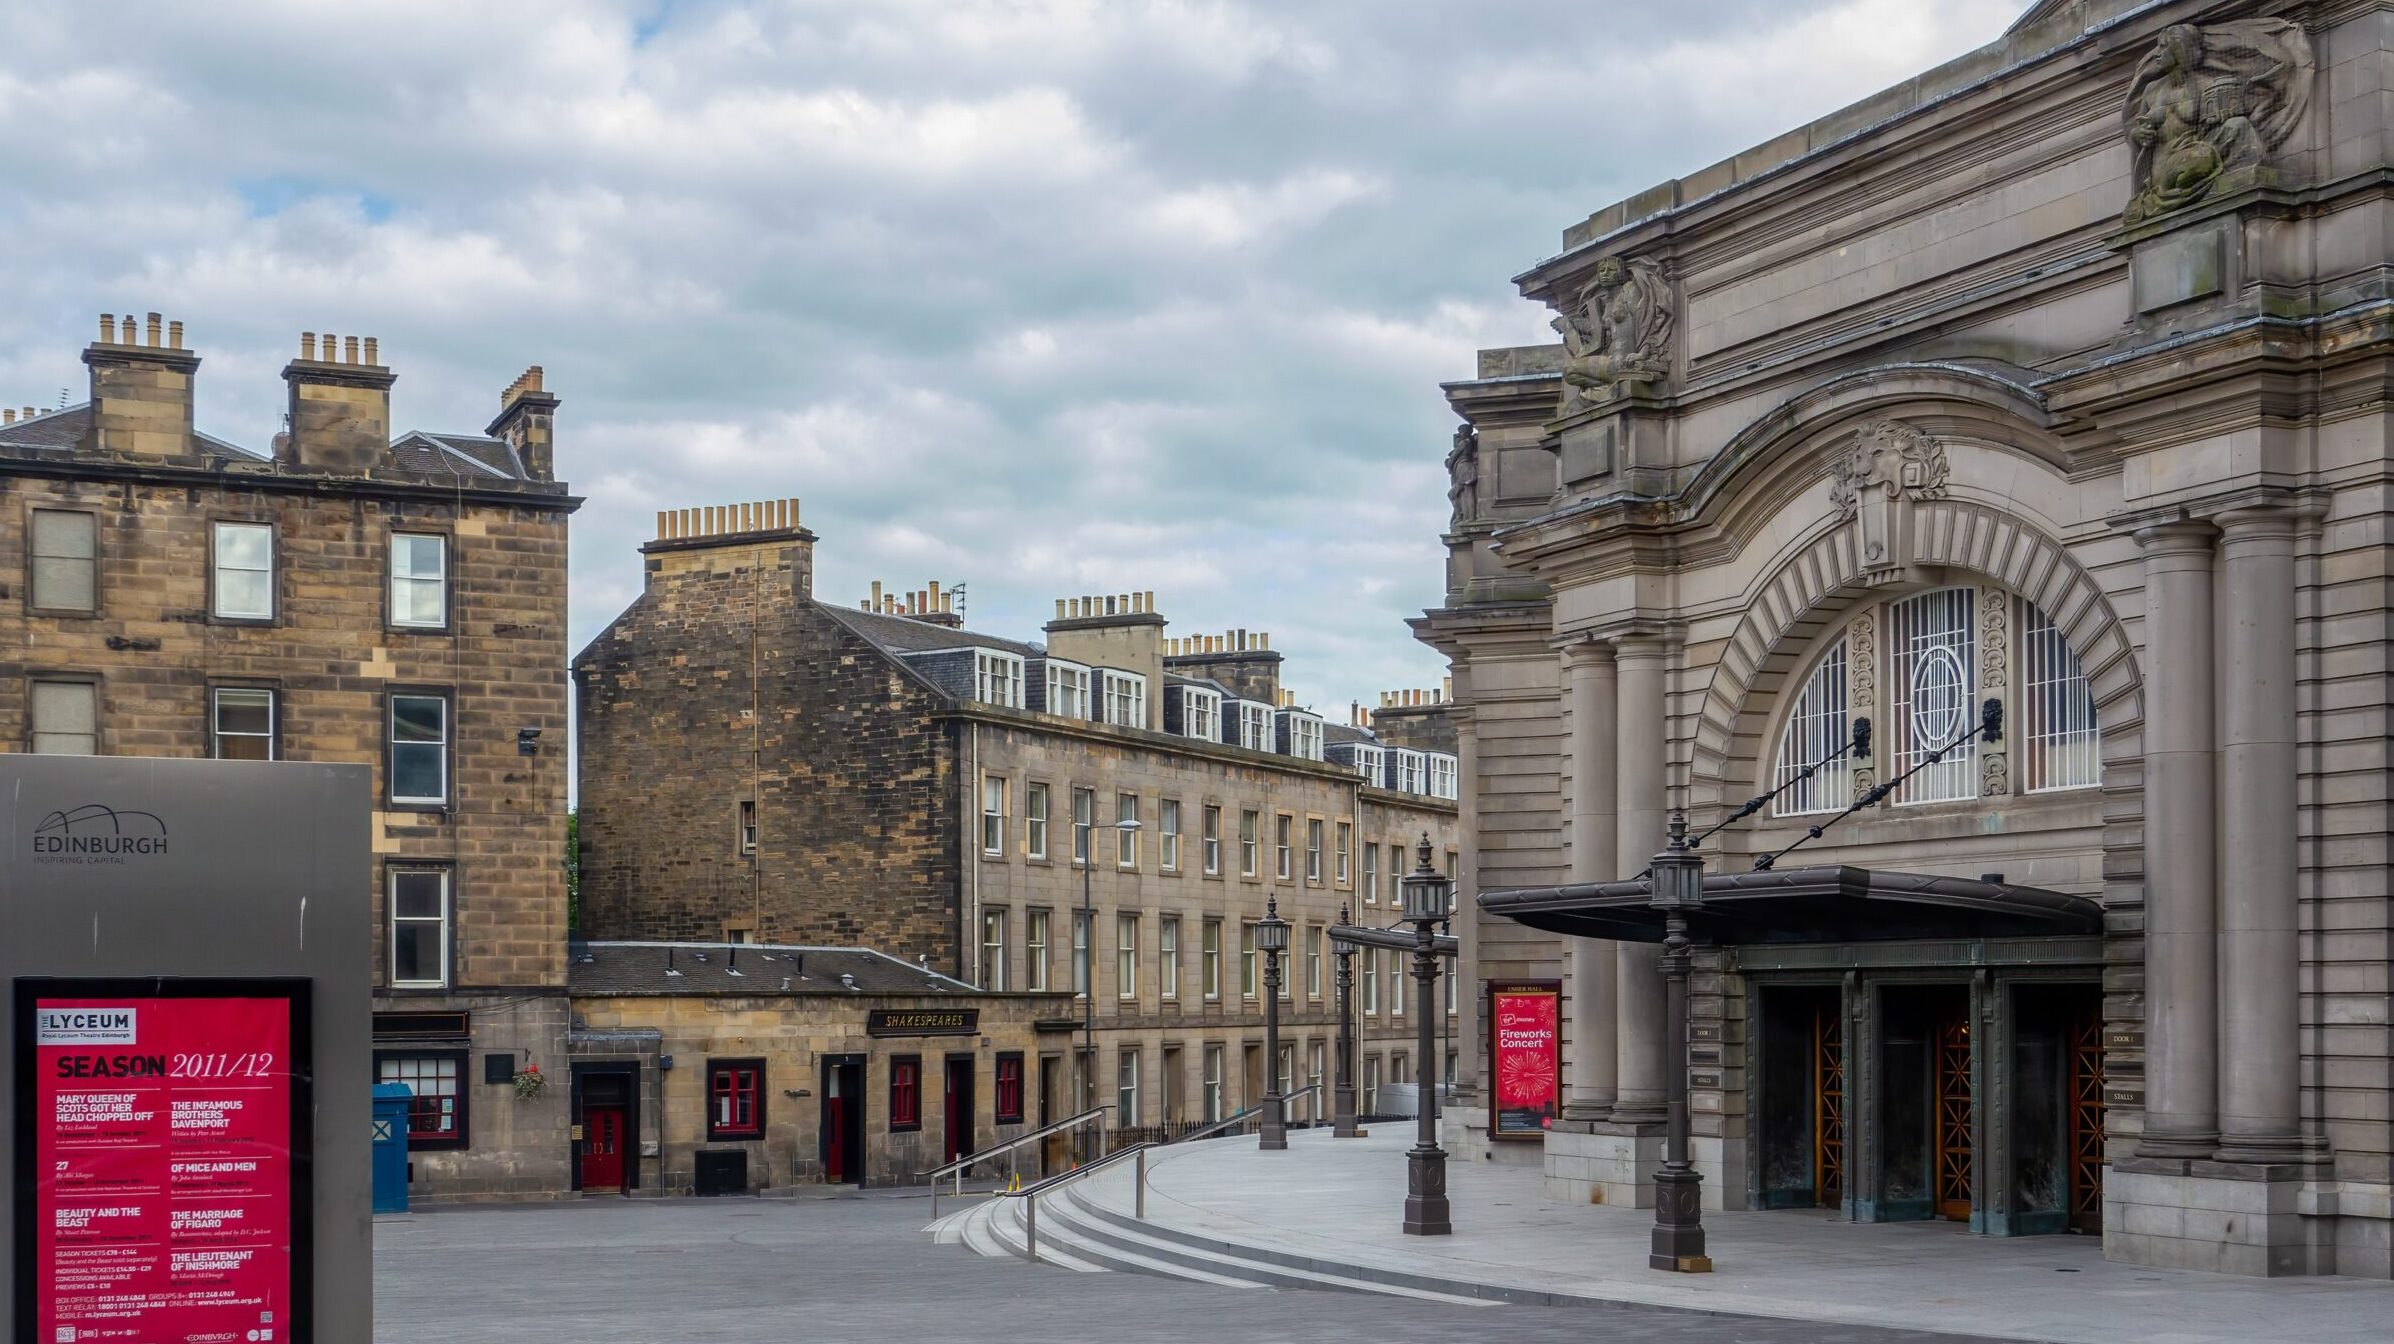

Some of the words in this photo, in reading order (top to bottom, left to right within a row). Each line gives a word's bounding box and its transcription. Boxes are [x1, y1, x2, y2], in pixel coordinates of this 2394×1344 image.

[34, 836, 167, 854] EDINBURGH
[34, 856, 82, 864] INSPIRING
[50, 1015, 128, 1028] LYCEUM
[885, 1015, 964, 1027] SHAKESPEARES
[1500, 1030, 1552, 1039] Fireworks
[1500, 1039, 1543, 1048] Concert
[56, 1056, 165, 1078] SEASON
[170, 1053, 272, 1077] 2011/12
[56, 1095, 86, 1103] MARY
[87, 1094, 121, 1103] QUEEN
[123, 1094, 137, 1102] OF
[56, 1104, 88, 1112] SCOTS
[90, 1104, 110, 1112] GOT
[111, 1103, 132, 1112] HER
[172, 1102, 191, 1110] THE
[192, 1101, 243, 1110] INFAMOUS
[56, 1113, 84, 1122] HEAD
[86, 1112, 132, 1121] CHOPPED
[134, 1112, 154, 1120] OFF
[171, 1110, 223, 1119] BROTHERS
[171, 1119, 230, 1128] DAVENPORT
[56, 1161, 69, 1170] 27
[171, 1164, 185, 1172] OF
[186, 1163, 210, 1172] MICE
[212, 1163, 233, 1172] AND
[234, 1162, 256, 1171] MEN
[56, 1209, 96, 1218] BEAUTY
[98, 1208, 119, 1217] AND
[120, 1207, 141, 1216] THE
[171, 1211, 191, 1220] THE
[192, 1209, 244, 1219] MARRIAGE
[56, 1218, 90, 1227] BEAST
[171, 1221, 185, 1229] OF
[186, 1220, 221, 1229] FIGARO
[171, 1253, 191, 1262] THE
[192, 1250, 253, 1261] LIEUTENANT
[171, 1262, 185, 1271] OF
[186, 1260, 240, 1270] INISHMORE
[198, 1298, 262, 1306] www.lyceum.org.uk
[85, 1310, 141, 1318] m.lyceum.org.uk
